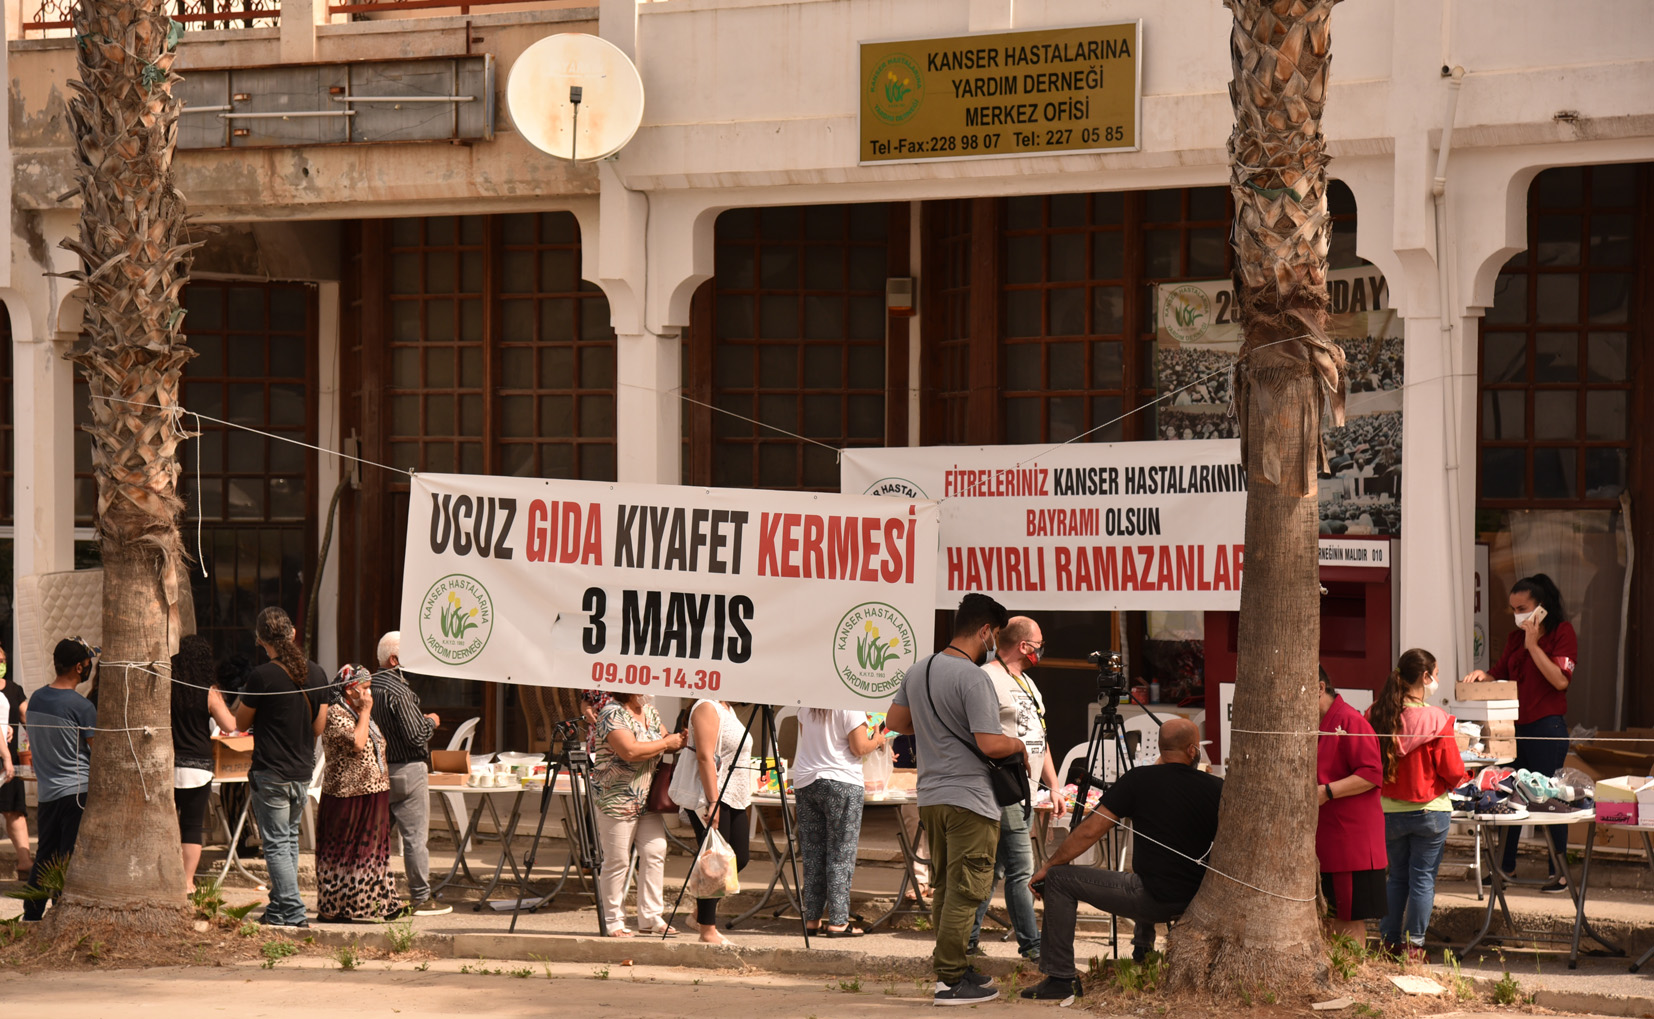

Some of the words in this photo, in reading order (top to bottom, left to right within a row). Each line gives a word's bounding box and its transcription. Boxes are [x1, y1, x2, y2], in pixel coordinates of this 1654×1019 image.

[927, 49, 999, 72] KANSER
[1004, 38, 1131, 67] HASTALARINA
[952, 76, 1017, 98] YARDIM
[1023, 65, 1104, 93] DERNEĞİ
[965, 104, 1038, 127] MERKEZ
[1043, 96, 1089, 123] OFİSİ
[961, 133, 979, 150] 98
[983, 133, 1001, 149] 07
[1013, 131, 1041, 147] Tel:
[1046, 129, 1073, 146] 227
[1081, 127, 1100, 143] 05
[1105, 126, 1124, 142] 85
[945, 463, 1049, 497] FİTRELERİNİZ
[1054, 467, 1119, 496] KANSER
[1125, 463, 1248, 495] HASTALARININ
[430, 492, 517, 560] UCUZ
[525, 498, 603, 566] GIDA
[614, 504, 749, 575] KIYAFET
[757, 504, 918, 584] KERMESİ
[1026, 508, 1100, 537] BAYRAMI
[1105, 507, 1161, 536] OLSUN
[947, 546, 1046, 591] HAYIRLI
[1054, 544, 1245, 591] RAMAZANLAR
[1345, 548, 1368, 561] MALIDIR
[1372, 549, 1383, 562] 010
[423, 583, 448, 620] KANSER
[448, 579, 489, 624] HASTALARINA
[582, 586, 607, 654] 3
[620, 589, 755, 664] MAYIS
[837, 611, 863, 650] KANSER
[863, 607, 912, 655] HASTALARINA
[427, 633, 452, 659] YARDIM
[451, 636, 483, 660] DERNEĞİ
[591, 661, 721, 691] 09.00-14.30
[841, 665, 870, 692] YARDIM
[871, 668, 906, 693] DERNEĞİ
